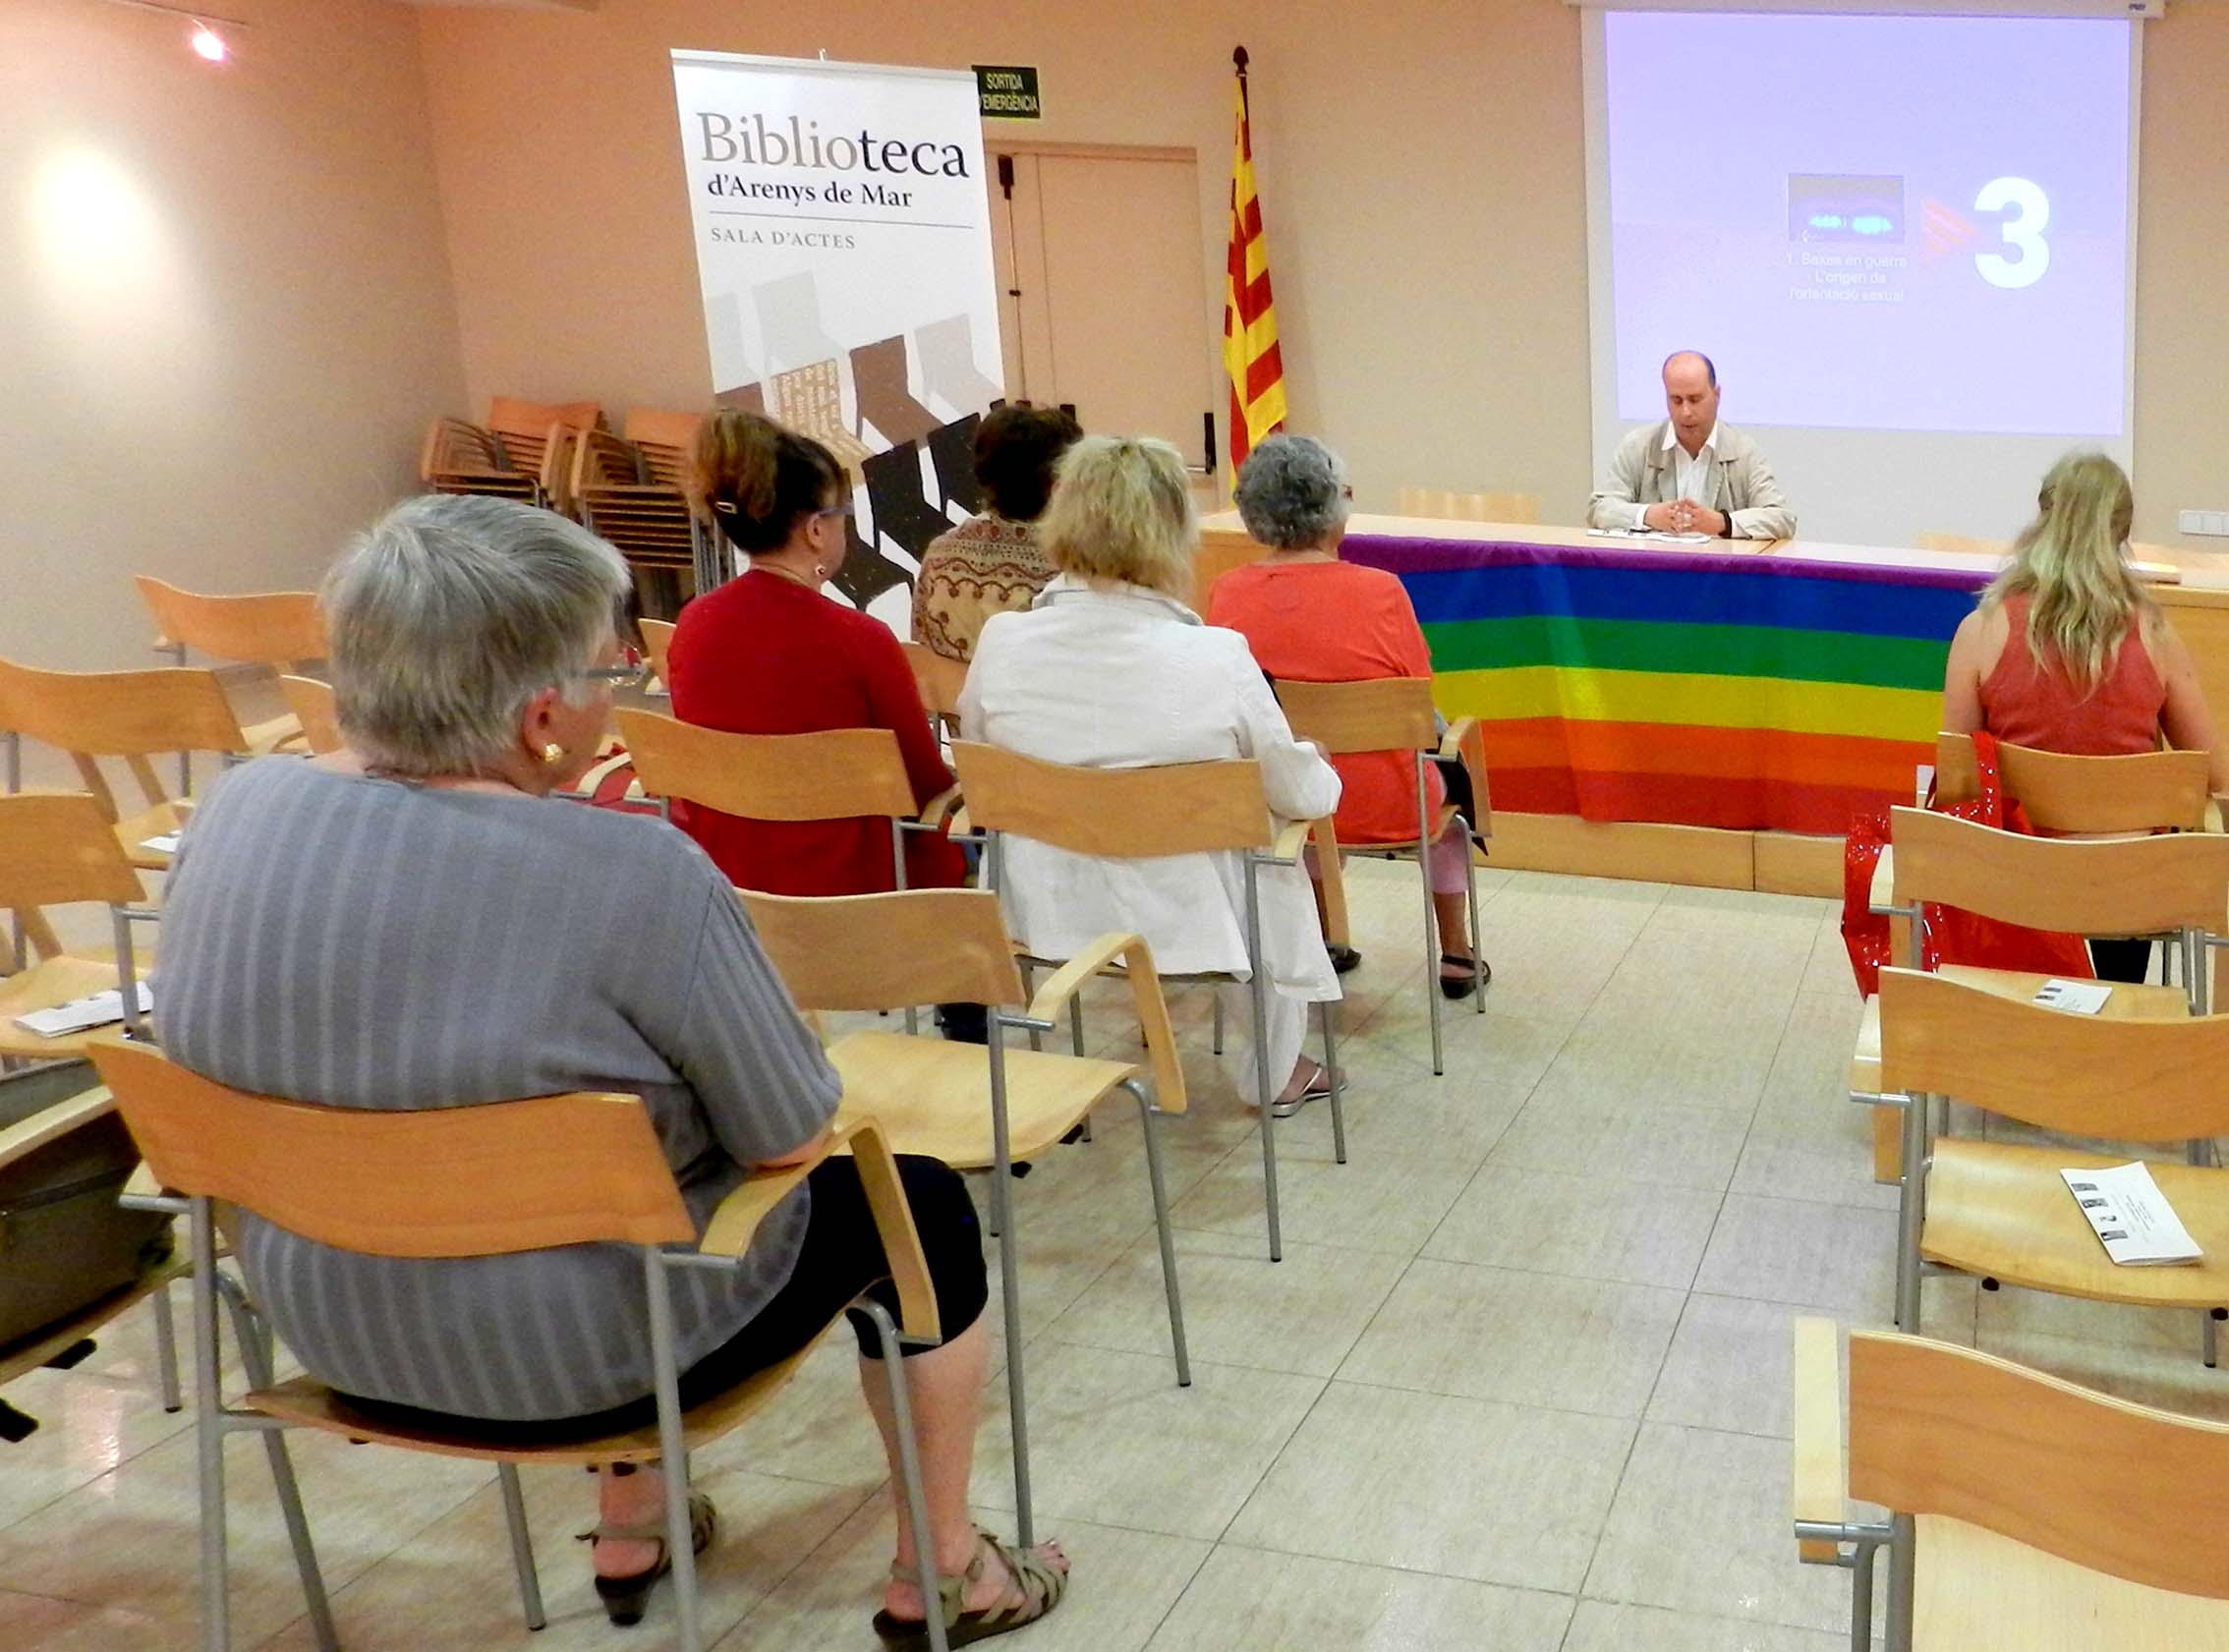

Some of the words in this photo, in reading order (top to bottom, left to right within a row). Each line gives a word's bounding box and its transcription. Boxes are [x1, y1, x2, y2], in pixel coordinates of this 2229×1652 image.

[986, 73, 1024, 90] SORTIDA
[696, 111, 970, 178] Biblioteca
[708, 173, 816, 206] d'Arenys
[824, 181, 853, 204] de
[861, 184, 912, 207] Mar
[711, 227, 764, 245] SALA
[772, 230, 856, 250] D'ACTES
[1973, 176, 2050, 289] 3
[1846, 256, 1861, 267] en
[1865, 256, 1908, 270] guerra
